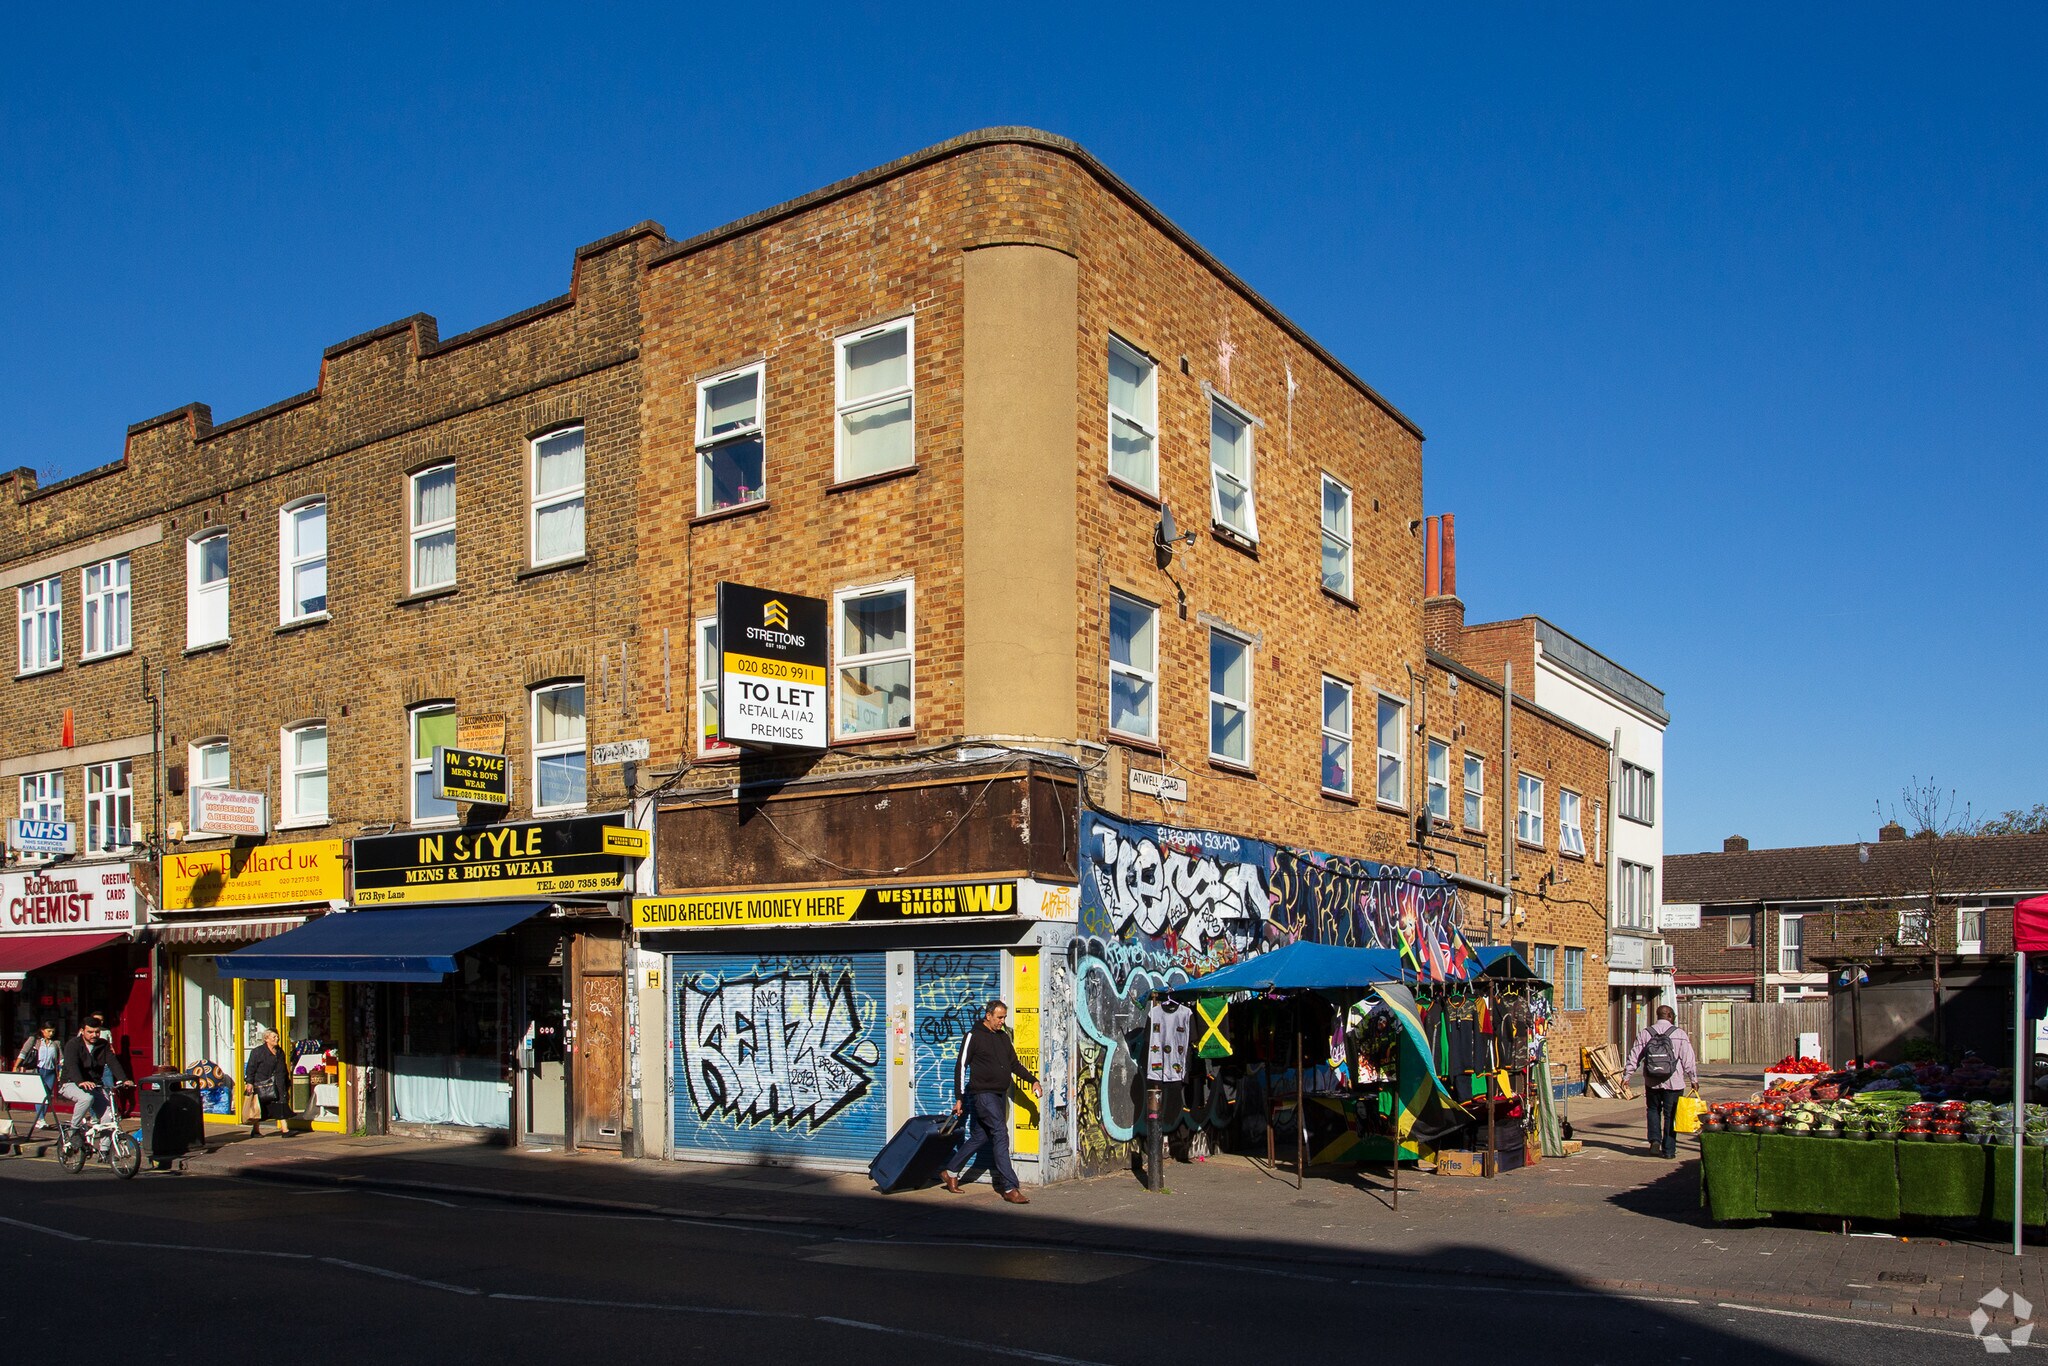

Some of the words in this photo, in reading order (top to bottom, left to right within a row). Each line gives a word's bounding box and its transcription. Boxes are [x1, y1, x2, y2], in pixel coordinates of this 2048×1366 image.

[746, 627, 805, 648] STRETTONS
[738, 659, 758, 673] 020
[762, 663, 788, 677] 8520
[791, 667, 815, 681] 9911
[738, 681, 770, 702] TO
[777, 686, 815, 708] LET
[740, 704, 778, 719] RETAIL
[462, 728, 499, 738] LANDLORDS
[751, 724, 804, 740] PREMISES
[446, 752, 460, 765] IN
[468, 756, 504, 771] STYLE
[451, 768, 472, 778] MENS
[472, 770, 478, 778] &
[480, 772, 498, 780] BOYS
[1132, 772, 1158, 787] ATWELL
[464, 780, 486, 789] WEAR
[474, 792, 488, 800] 7358
[206, 804, 256, 814] HOUSEHOLD
[207, 812, 213, 820] &
[214, 813, 254, 823] BEDROOM
[21, 820, 66, 840] NHS
[203, 822, 259, 832] ACCESSORIES
[419, 834, 444, 864] IN
[453, 827, 542, 860] STYLE
[1157, 827, 1202, 846] RUSSIAN
[1204, 832, 1240, 852] SQUAD
[176, 856, 214, 879] New
[220, 848, 293, 876] Pollard
[299, 855, 318, 868] UK
[102, 873, 130, 885] GREETING
[406, 868, 444, 883] MENS
[448, 868, 459, 880] &
[463, 864, 500, 880] BOYS
[506, 860, 554, 876] WEAR
[24, 875, 78, 896] RoPharm
[537, 881, 556, 890] TEL:
[558, 880, 574, 889] 020
[578, 878, 598, 888] 7358
[600, 877, 620, 886] 9549
[106, 889, 126, 900] CARDS
[257, 891, 280, 899] VARIETY
[292, 889, 322, 898] BEDDINGS
[358, 892, 372, 900] 173
[373, 891, 385, 902] Rye
[388, 890, 405, 899] Lane
[877, 887, 956, 903] WESTERN
[964, 884, 1012, 912] WU
[10, 892, 94, 926] CHEMIST
[104, 911, 114, 920] 732
[116, 910, 129, 920] 4560
[748, 898, 801, 919] MONEY
[806, 896, 845, 916] HERE
[901, 900, 956, 915] UNION
[790, 1069, 815, 1086] 2018
